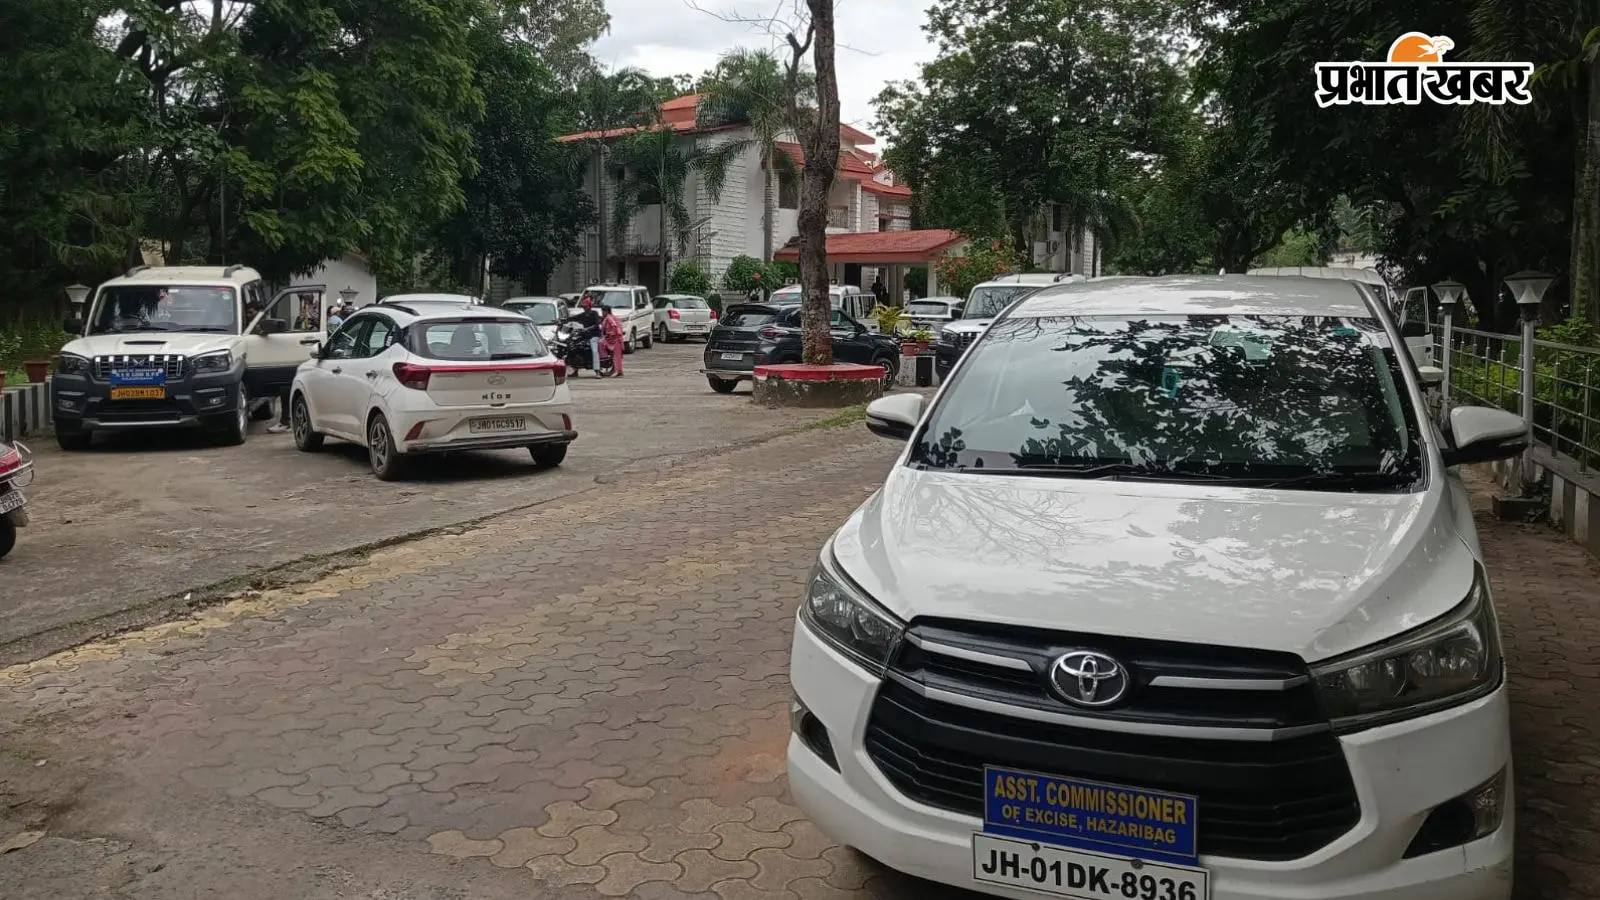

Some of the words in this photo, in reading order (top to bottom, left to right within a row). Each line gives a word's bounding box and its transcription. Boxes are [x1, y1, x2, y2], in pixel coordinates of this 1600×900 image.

[994, 775, 1041, 803] ASST.
[1046, 783, 1187, 825] COMMISSIONER
[1002, 804, 1021, 820] OF
[1025, 808, 1082, 832] EXCISE,
[1086, 816, 1176, 844] HAZARIBAG
[981, 849, 1197, 900] JH-01DK-8936
